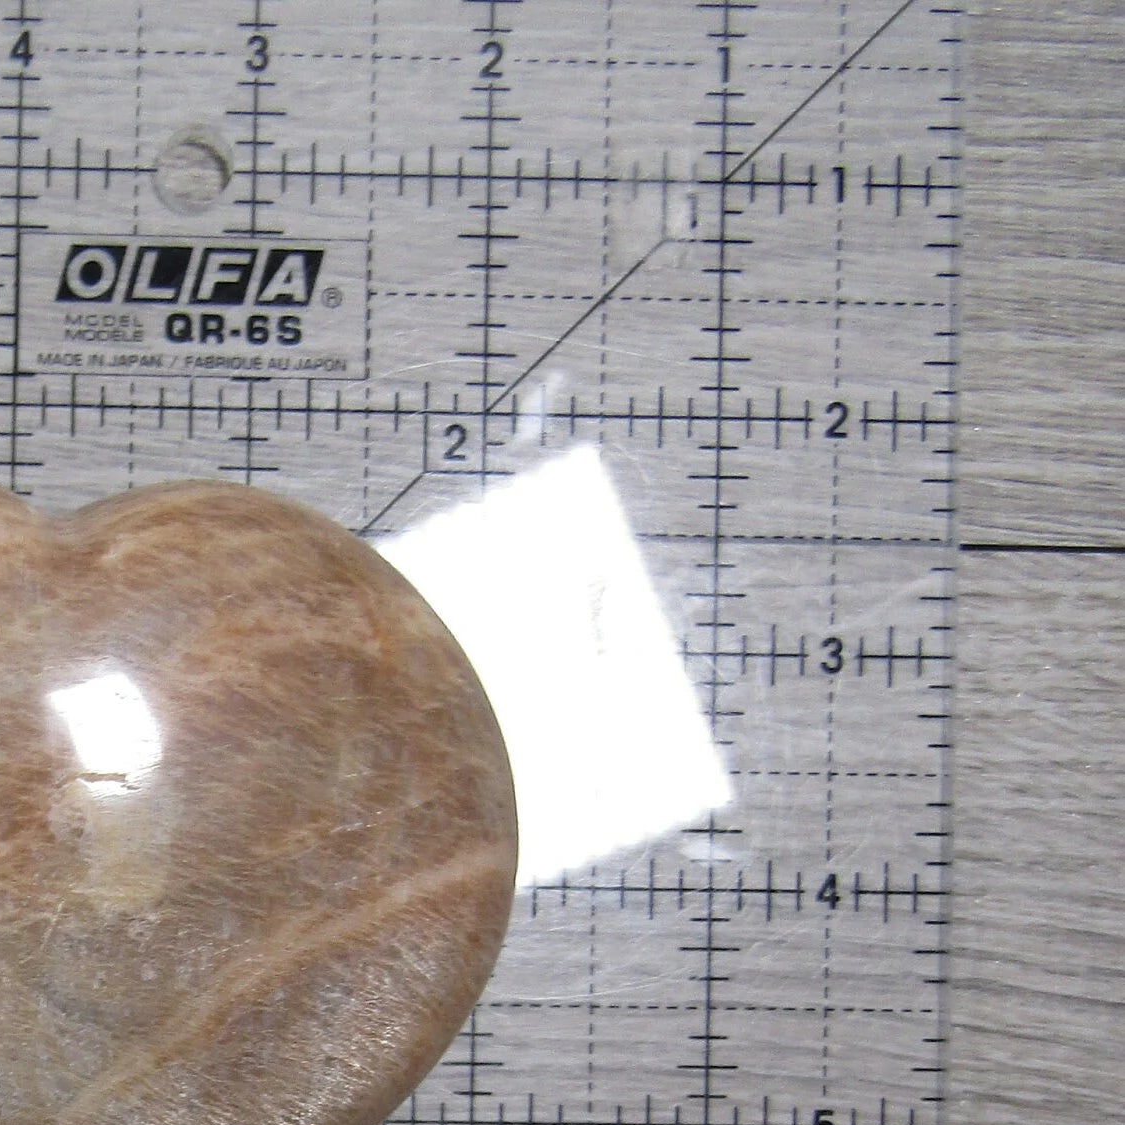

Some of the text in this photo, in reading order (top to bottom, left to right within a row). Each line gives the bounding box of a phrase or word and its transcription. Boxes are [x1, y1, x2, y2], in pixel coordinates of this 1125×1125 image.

[10, 31, 35, 68] 4
[246, 36, 270, 72] 3
[480, 41, 504, 78] 2
[717, 47, 730, 83] 1
[833, 167, 846, 201] 1
[59, 246, 321, 305] OLFA
[165, 312, 303, 346] QR-6S
[37, 352, 83, 366] MADE
[88, 353, 105, 367] IN
[108, 354, 164, 368] JAPAN
[268, 357, 291, 371] AU
[294, 357, 348, 372] JAPON
[826, 402, 849, 439] 2
[445, 424, 468, 461] 2
[820, 637, 844, 674] 3
[816, 873, 840, 910] 4
